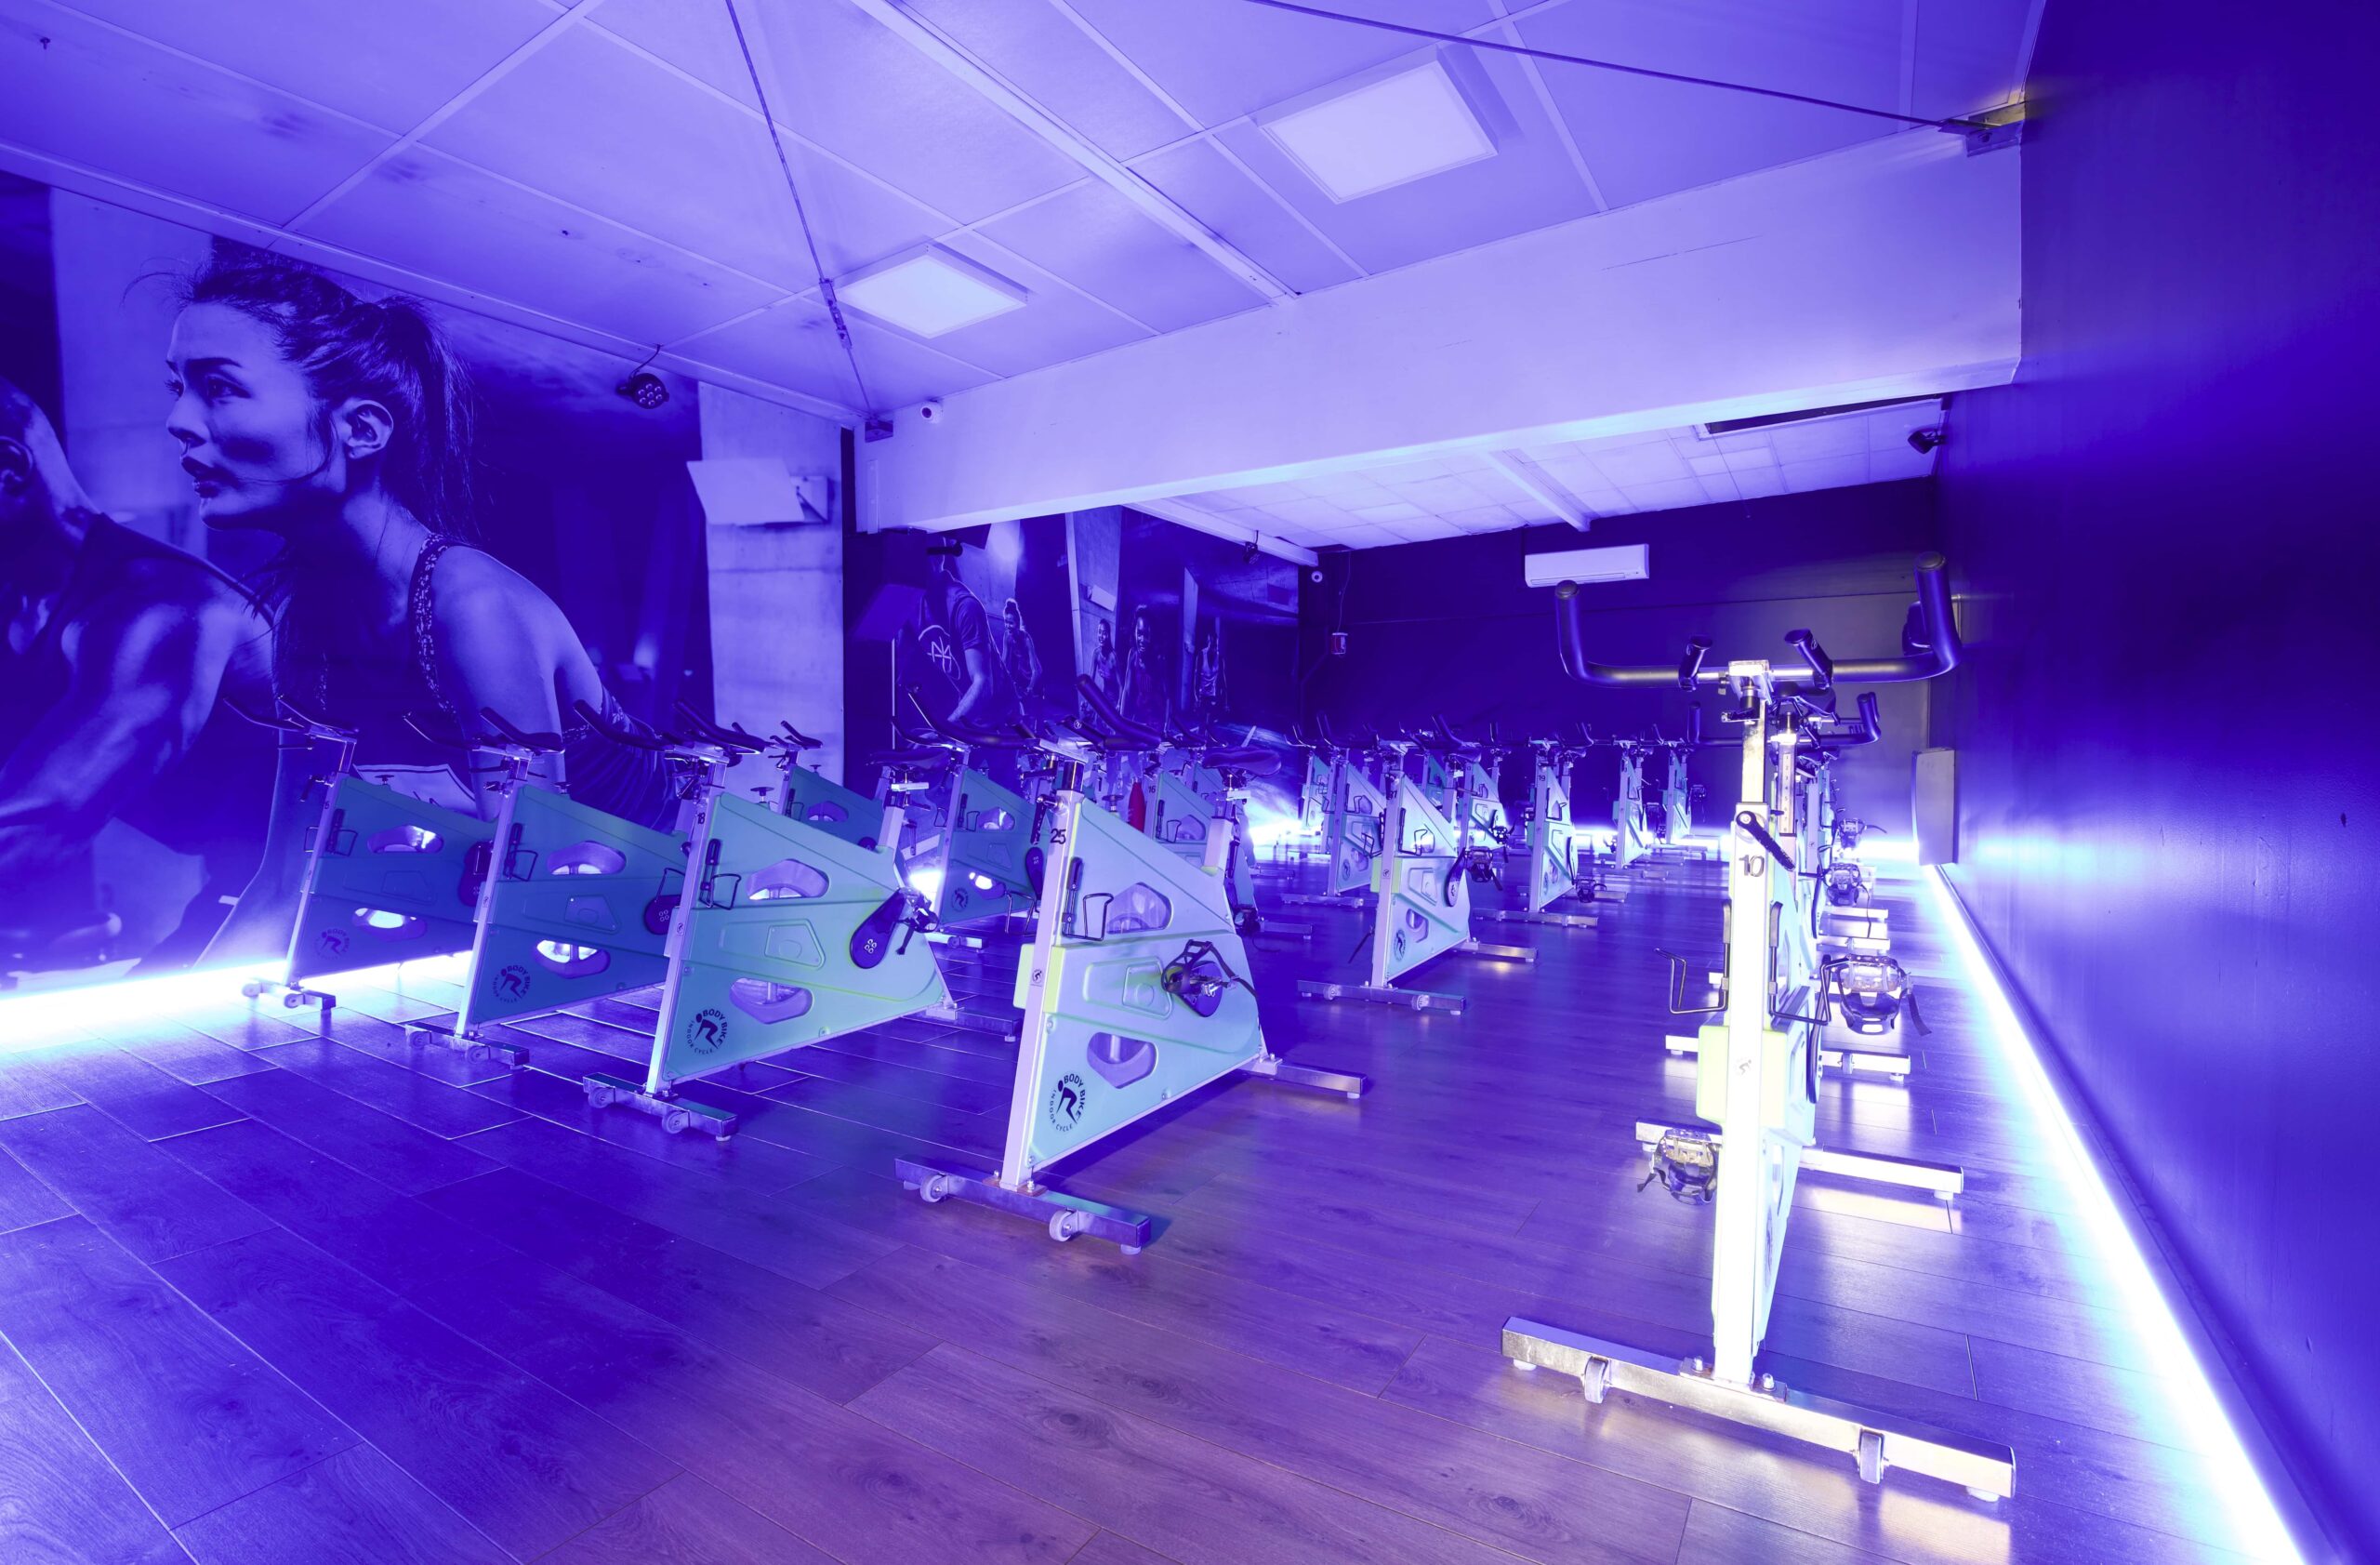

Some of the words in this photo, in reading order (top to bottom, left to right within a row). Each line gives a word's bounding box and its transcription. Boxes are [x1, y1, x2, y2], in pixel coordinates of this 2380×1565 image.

[697, 812, 706, 825] 18
[1050, 828, 1066, 845] 25
[1738, 854, 1765, 878] 10
[702, 1008, 726, 1021] BODY
[716, 1022, 728, 1048] BIKE
[1049, 1089, 1057, 1123] INDOOR
[1064, 1073, 1084, 1088] BODY
[1075, 1089, 1086, 1121] BIKE
